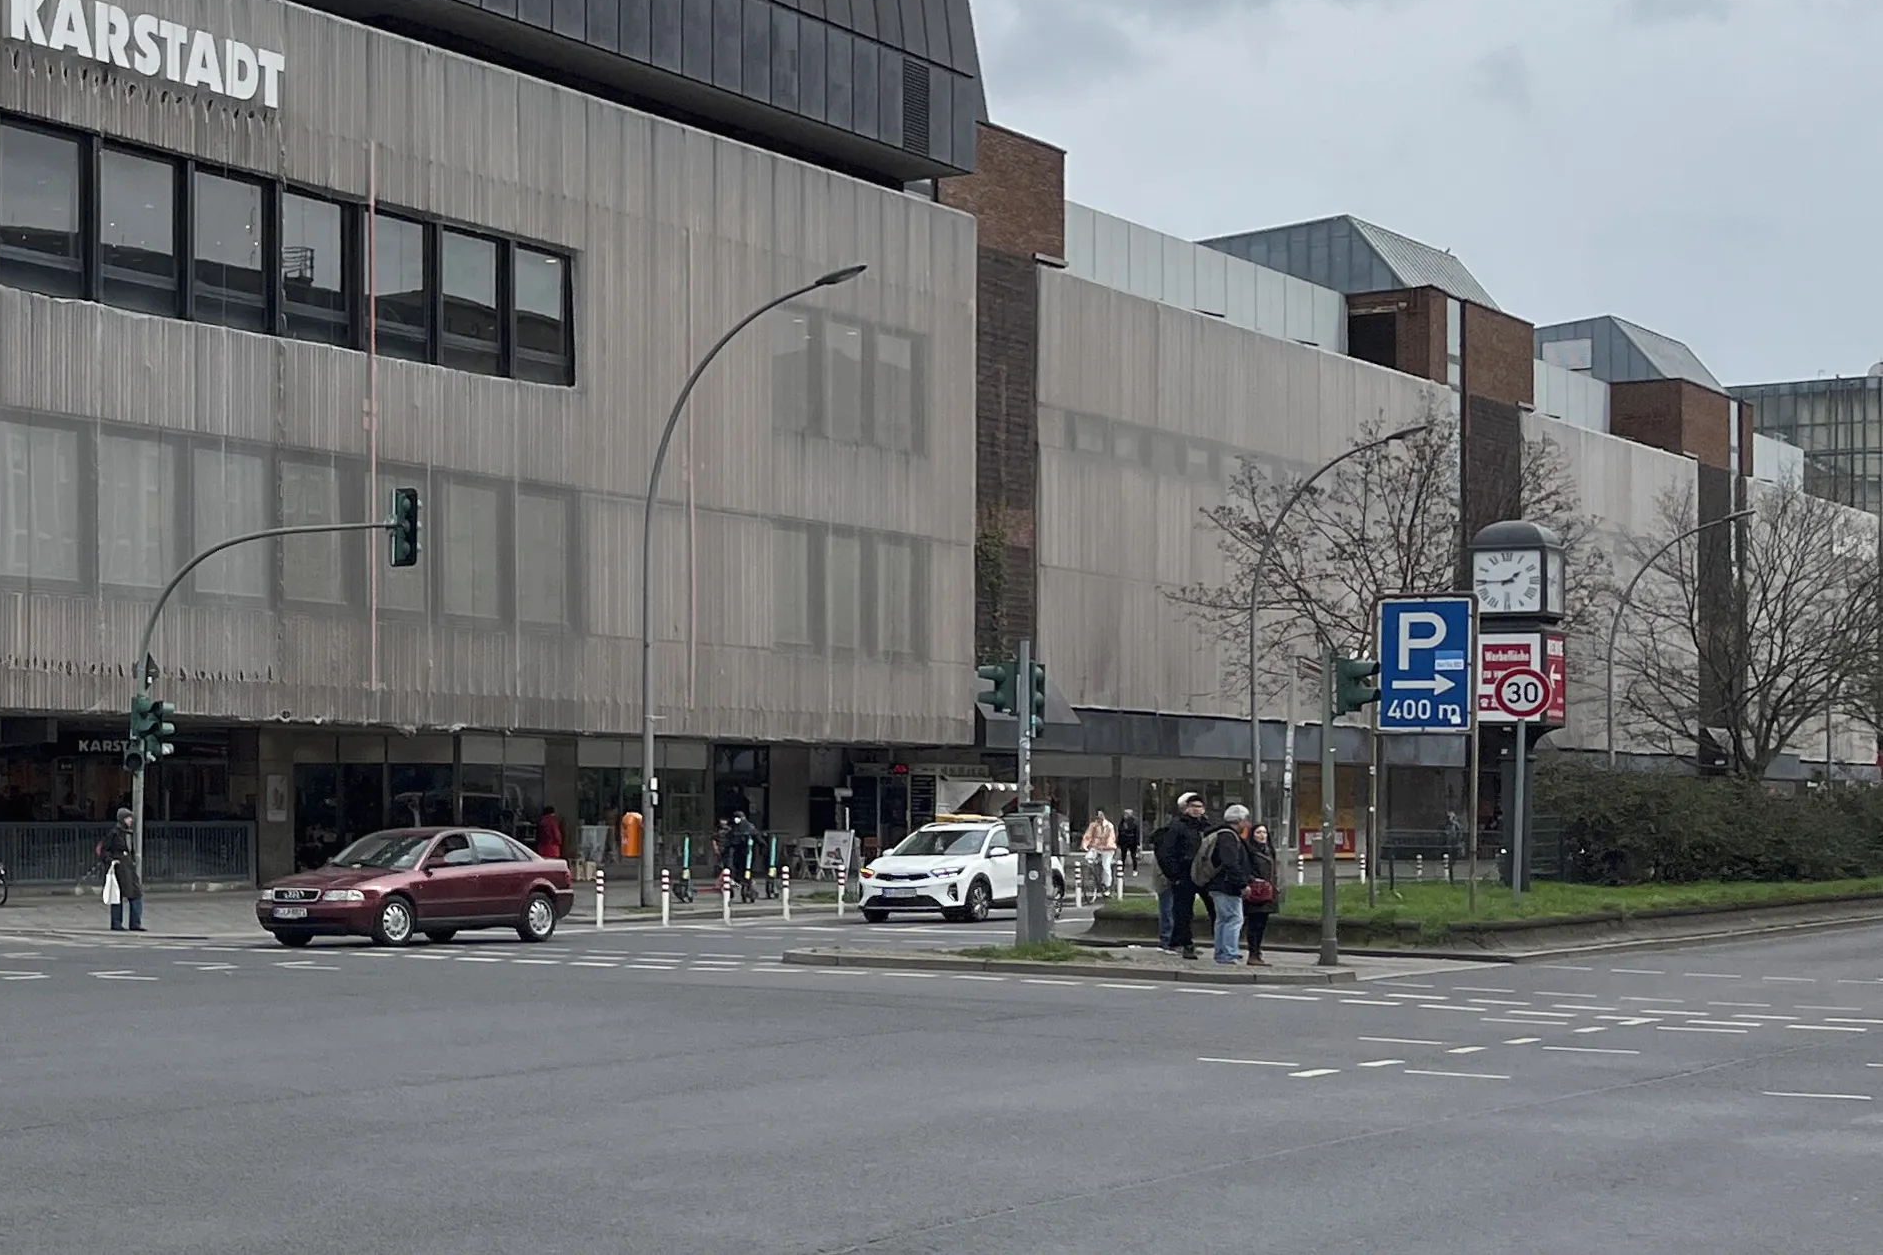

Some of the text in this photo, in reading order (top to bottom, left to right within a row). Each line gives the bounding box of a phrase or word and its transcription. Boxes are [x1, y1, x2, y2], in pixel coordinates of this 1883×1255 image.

[1399, 612, 1447, 670] P
[1506, 681, 1539, 704] 30
[1387, 699, 1431, 720] 400
[78, 739, 130, 752] KARST
